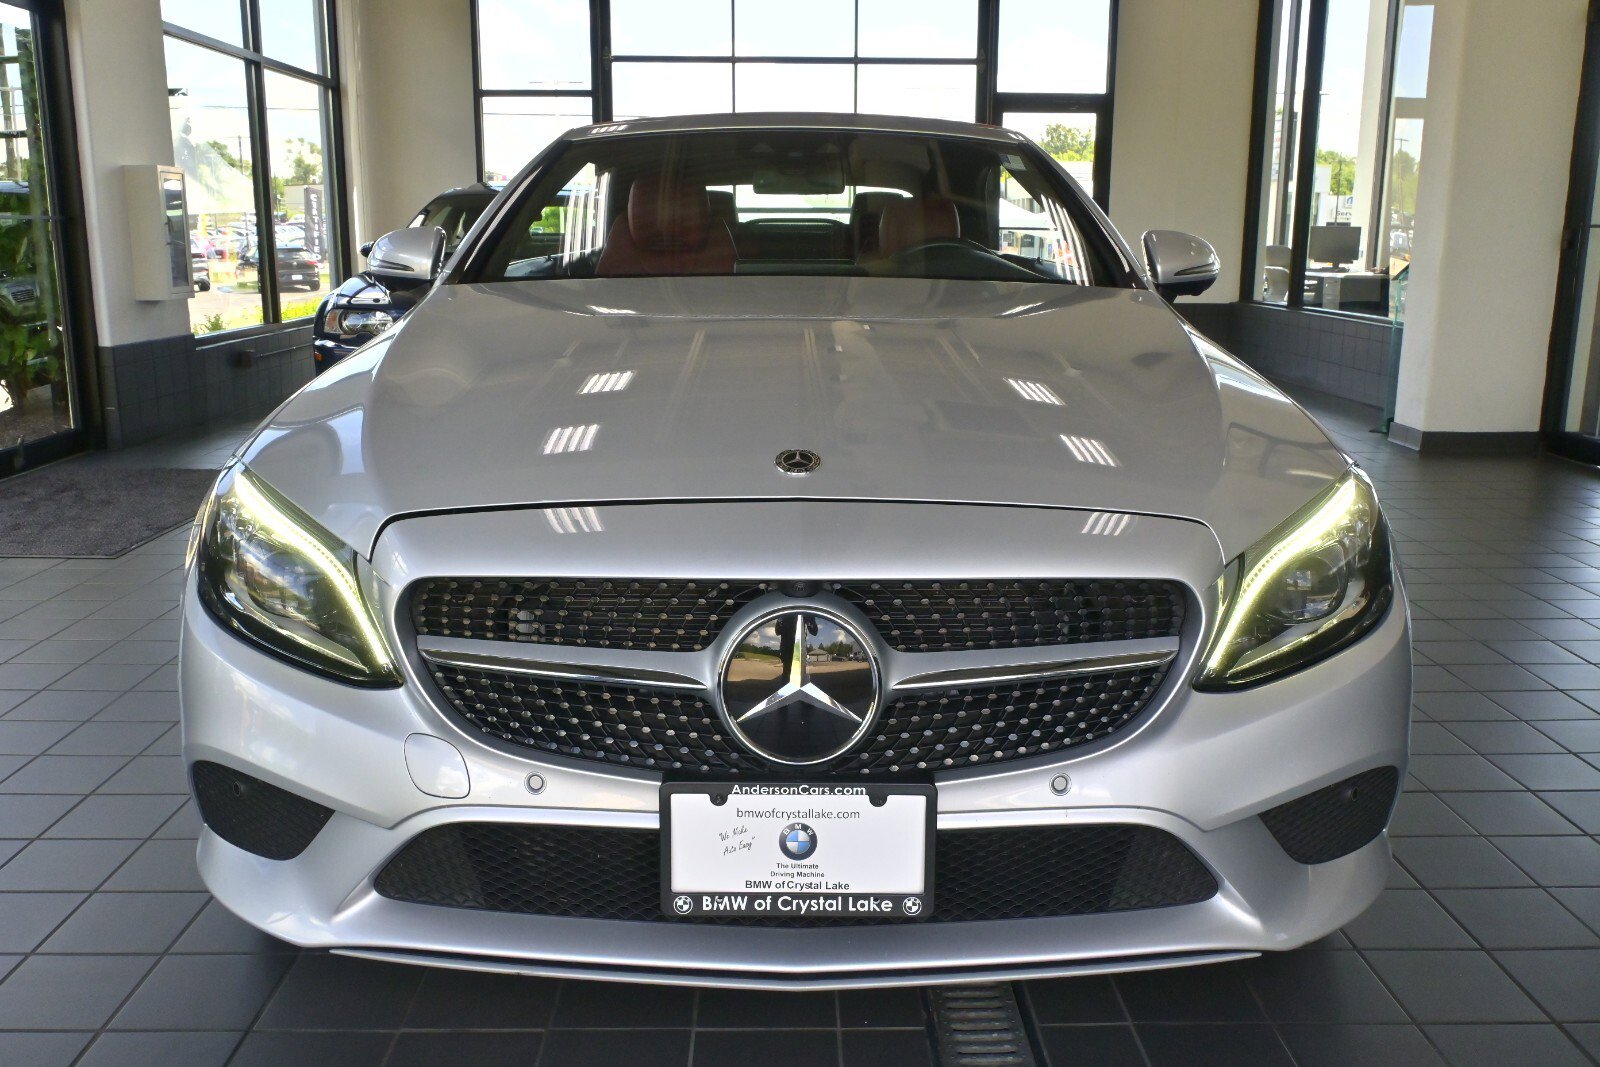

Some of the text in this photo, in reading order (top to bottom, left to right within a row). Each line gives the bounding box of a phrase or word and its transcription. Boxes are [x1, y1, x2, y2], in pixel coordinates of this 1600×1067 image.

[731, 784, 866, 795] AndersonCars.com
[736, 808, 860, 820] bmwofcrystallake.com
[782, 823, 814, 836] BMW
[745, 880, 850, 891] BMW of Crystal Lake
[702, 895, 748, 911] BMW
[754, 895, 772, 911] of
[777, 895, 842, 915] Crystal
[848, 896, 893, 912] Lake
